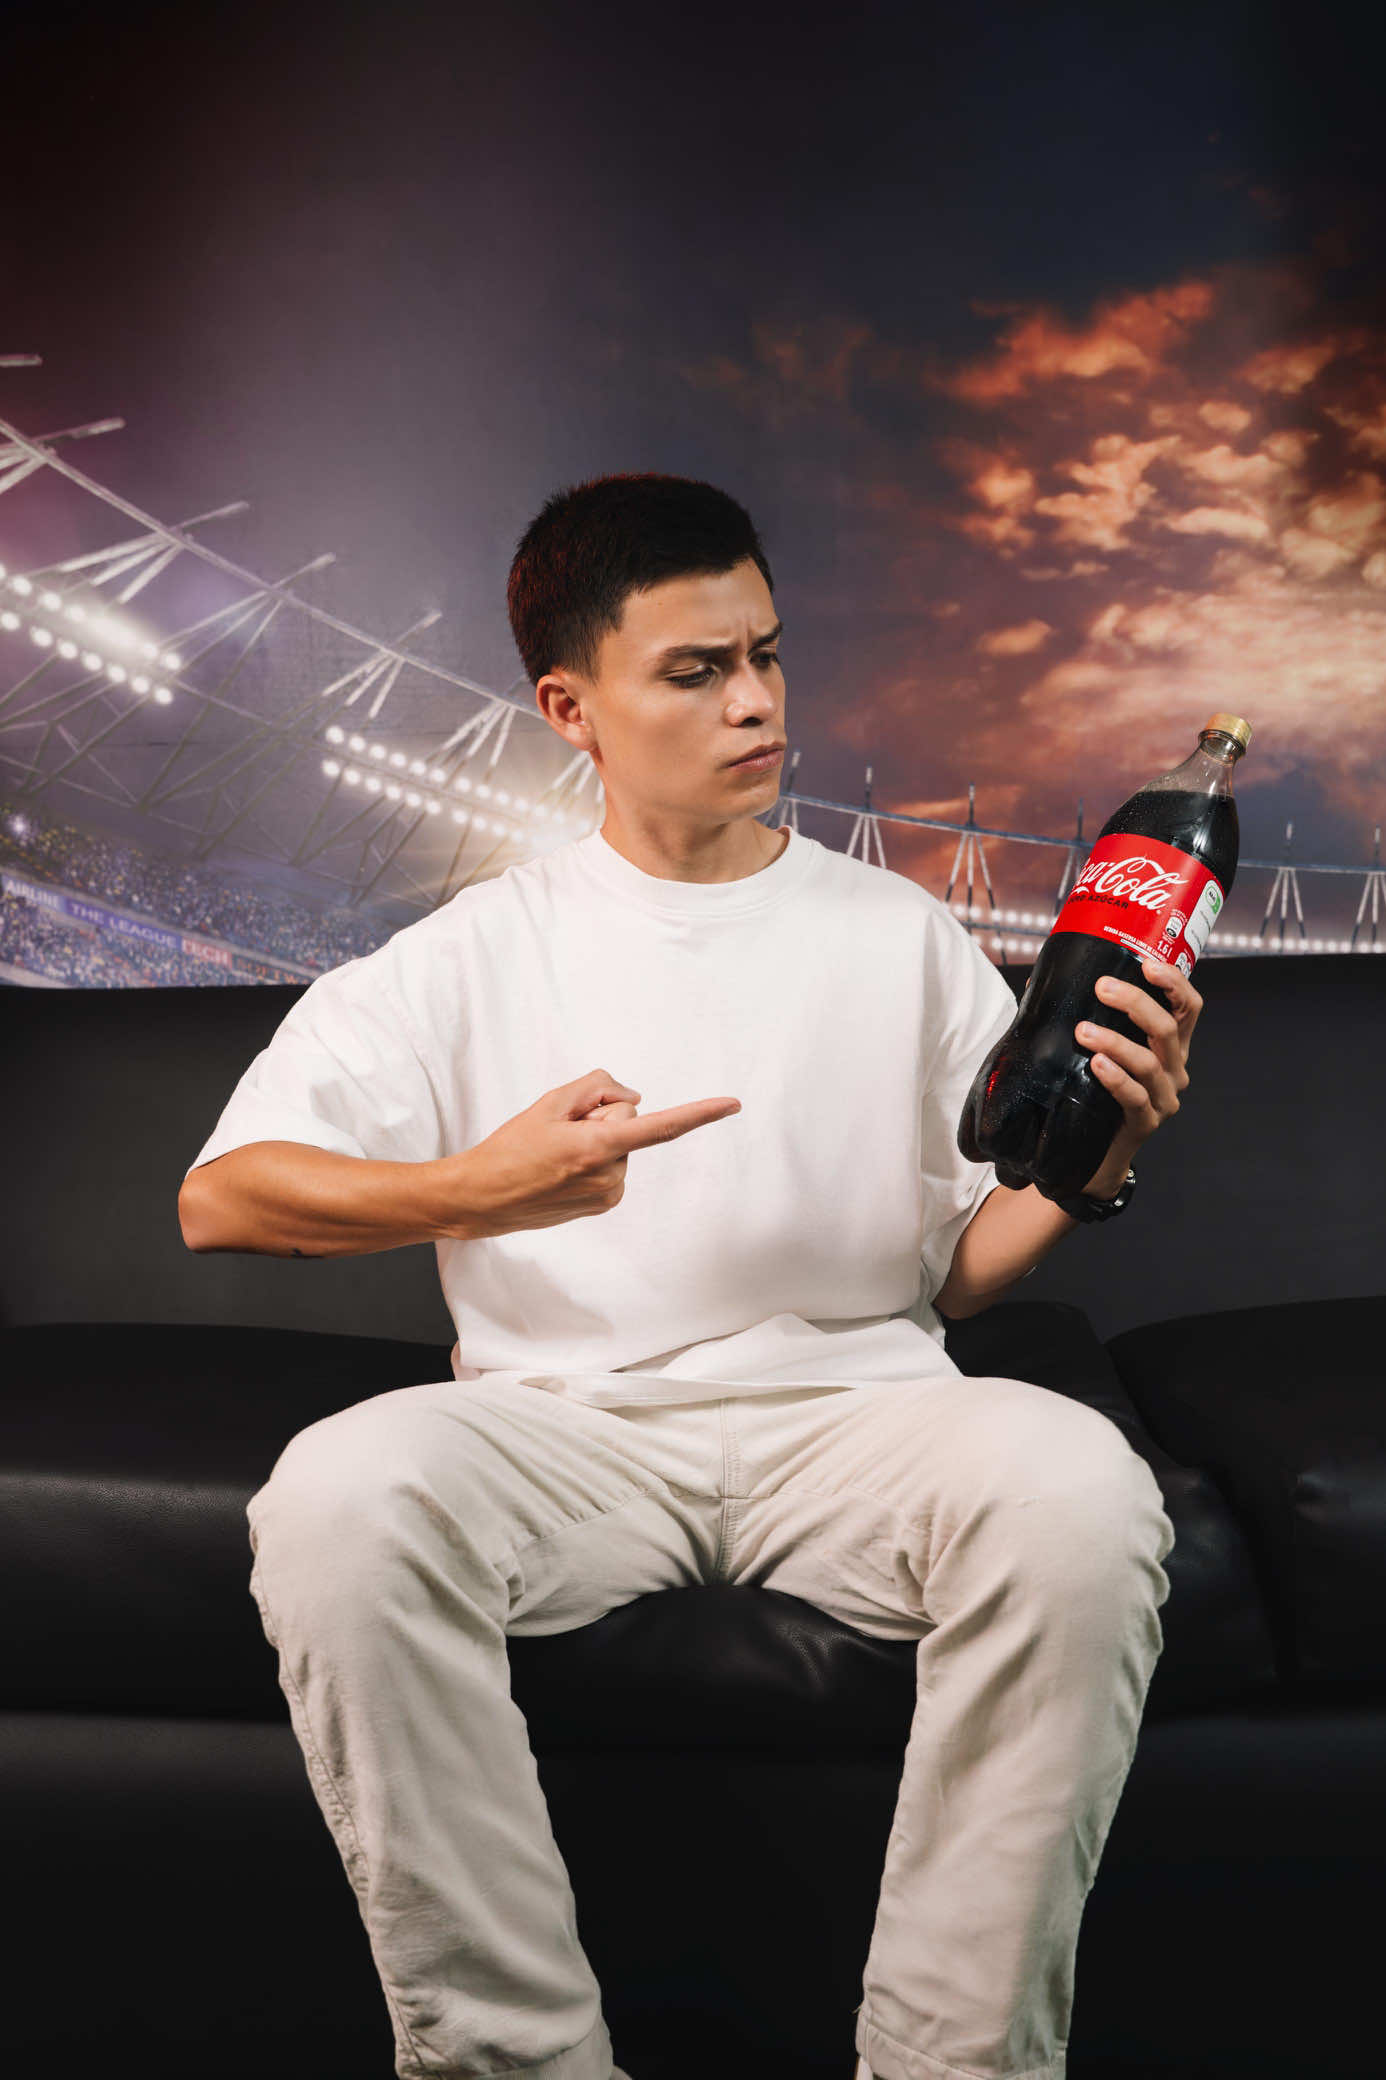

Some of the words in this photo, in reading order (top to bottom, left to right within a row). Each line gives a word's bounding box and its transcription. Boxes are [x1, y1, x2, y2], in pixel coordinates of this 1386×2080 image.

[1077, 856, 1189, 910] ca-Cola
[71, 903, 104, 925] THE
[108, 916, 176, 948] LEAGUE
